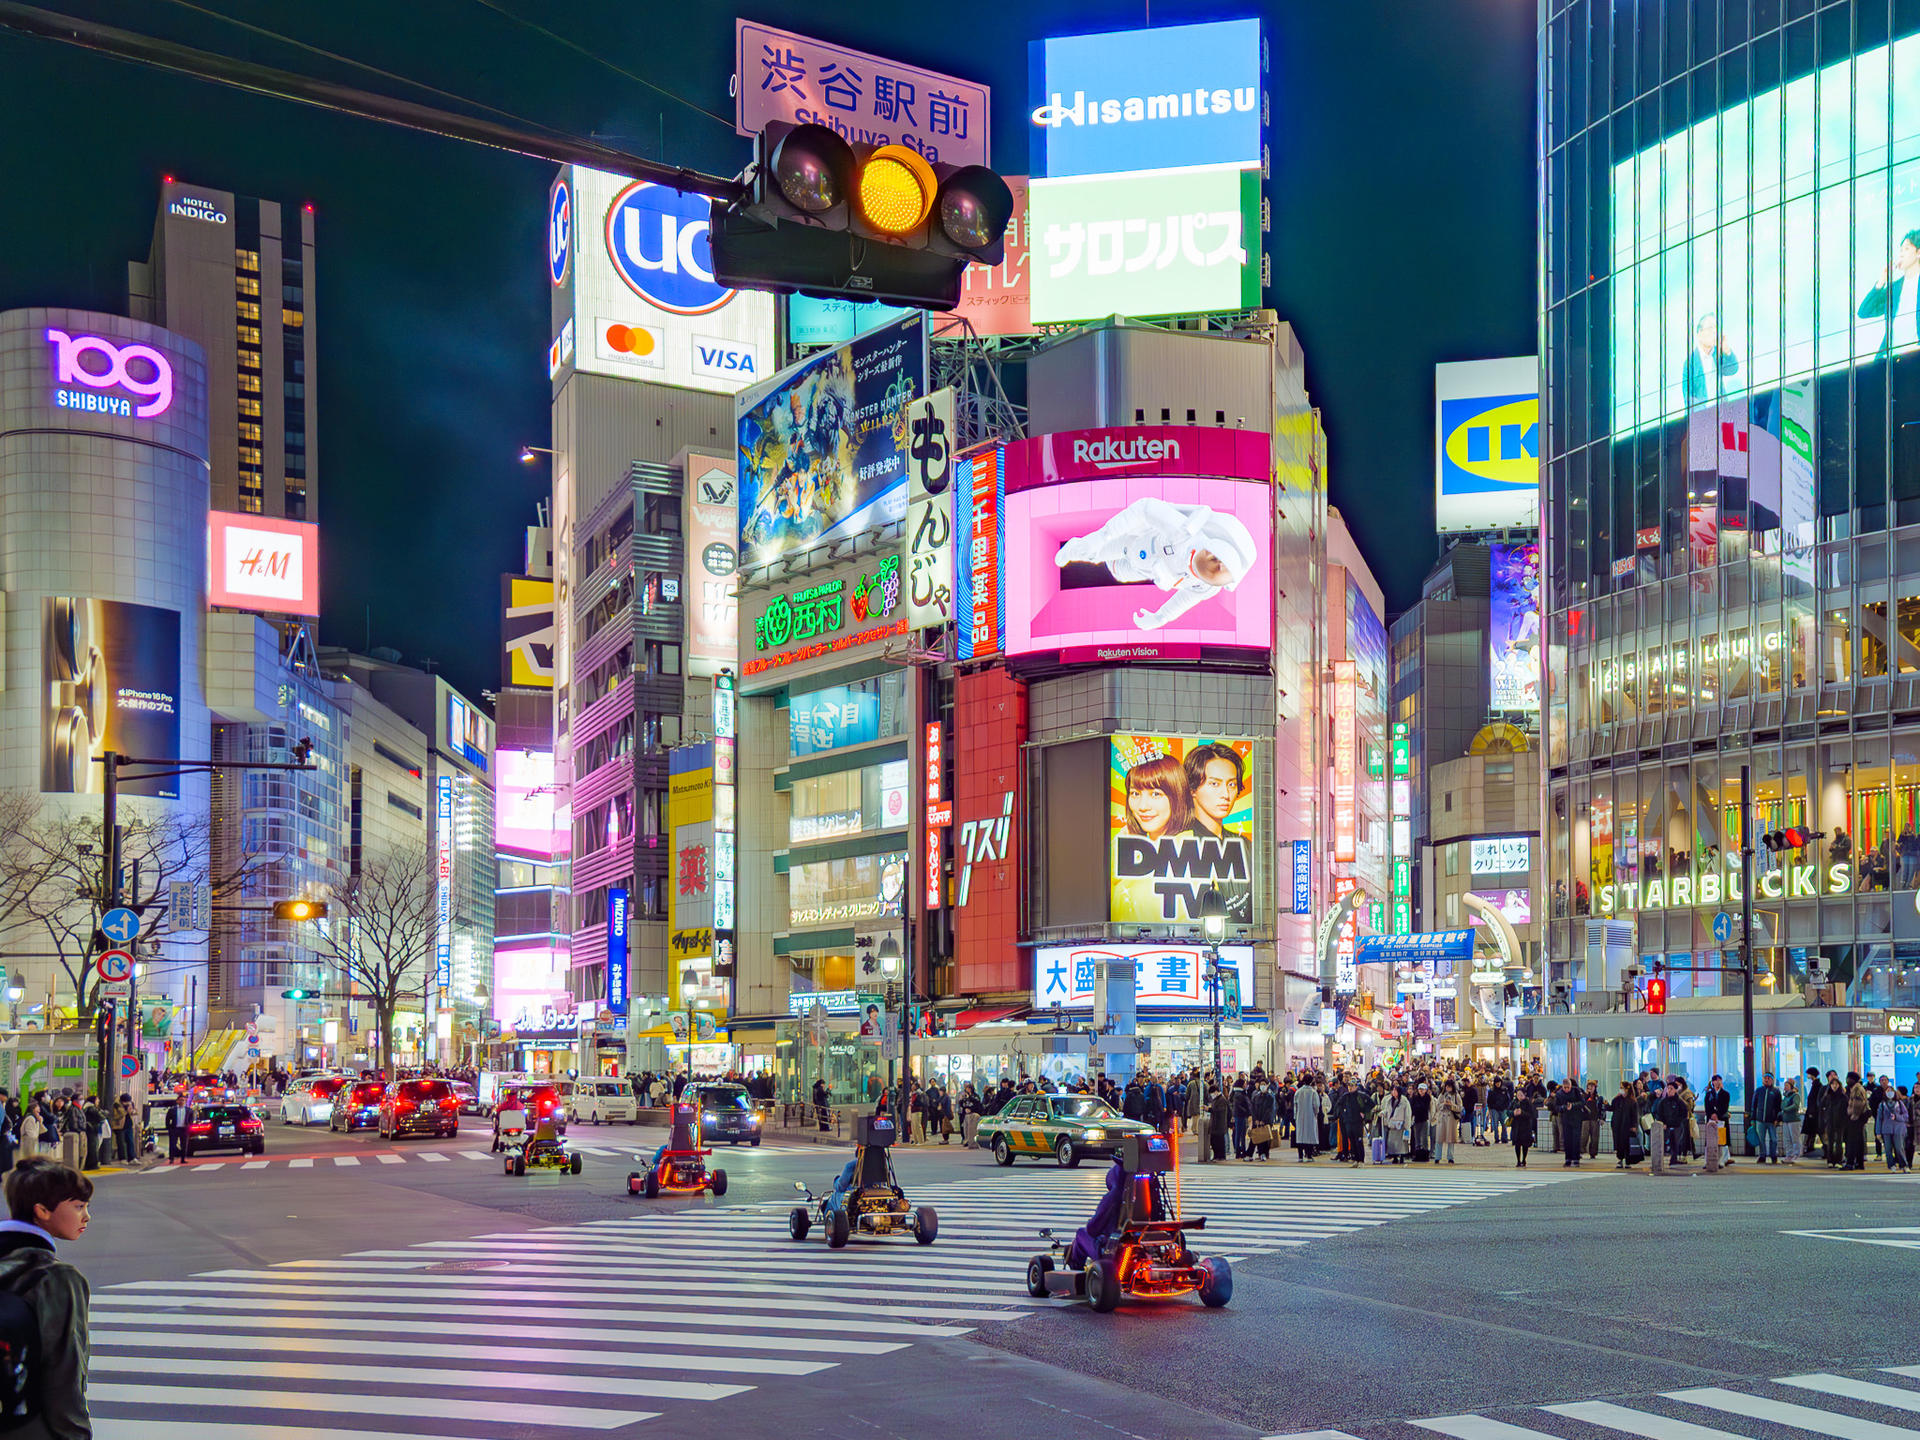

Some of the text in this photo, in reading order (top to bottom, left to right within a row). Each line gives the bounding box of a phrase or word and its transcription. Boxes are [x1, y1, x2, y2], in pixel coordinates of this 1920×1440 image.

[761, 44, 969, 139] 渋谷駅前
[1031, 87, 1255, 127] Hisamitsu
[170, 204, 227, 224] INDIGO
[183, 197, 214, 210] HOTEL
[1043, 211, 1247, 278] サロンパス
[696, 345, 755, 374] VISA
[854, 339, 908, 369] モンスターハンター
[46, 328, 173, 418] 109
[57, 389, 131, 417] SHIBUYA
[880, 389, 914, 412] HUNTER
[1074, 438, 1180, 463] Rakuten
[858, 455, 901, 482] 好評発売中
[909, 401, 951, 617] もんじゃ
[239, 548, 291, 580] H&M
[793, 594, 843, 640] 西村
[1097, 647, 1158, 659] Rakuten Vision
[126, 688, 152, 699] iPhone
[161, 694, 173, 702] Pro
[440, 787, 451, 816] LABI
[440, 850, 449, 878] LABI
[1116, 839, 1247, 881] DMM
[1474, 858, 1527, 870] クリニック
[1488, 843, 1527, 856] れいわ
[680, 843, 708, 896] 薬
[1296, 844, 1309, 911] 大盛堂商事ビル
[1600, 863, 1852, 912] STARBUCKS
[615, 898, 624, 937] MIZUHO
[1367, 932, 1467, 946] 火災予防運動実施中
